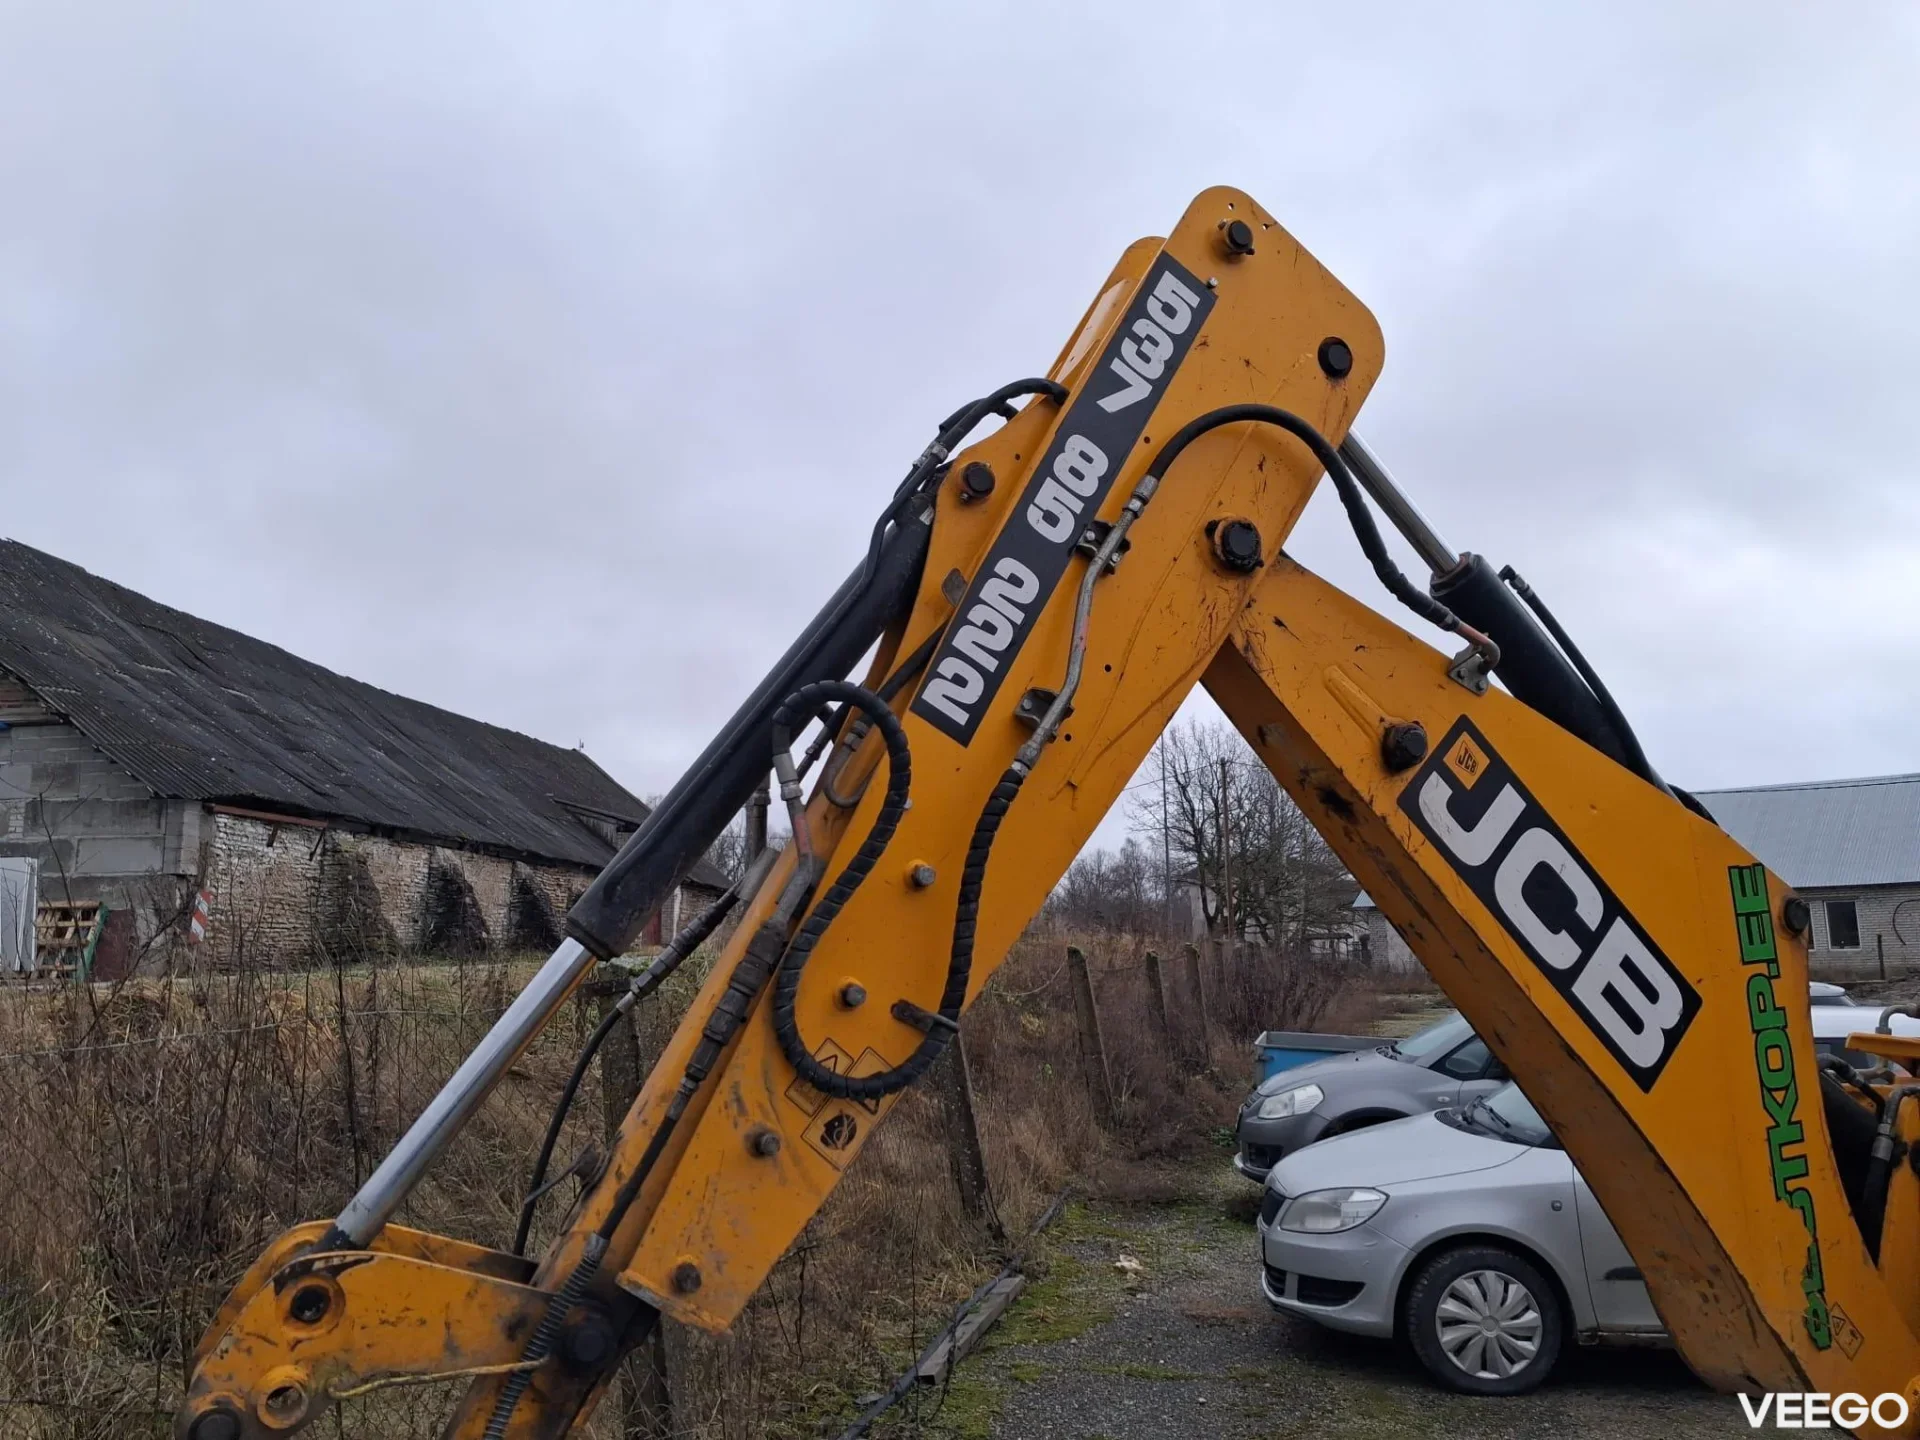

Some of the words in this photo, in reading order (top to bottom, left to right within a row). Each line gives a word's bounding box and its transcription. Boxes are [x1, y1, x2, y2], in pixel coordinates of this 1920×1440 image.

[1096, 270, 1201, 414] 537
[1026, 434, 1109, 544] 85
[921, 557, 1040, 726] 222
[1458, 747, 1478, 774] JCB
[1418, 770, 1683, 1068] JCB
